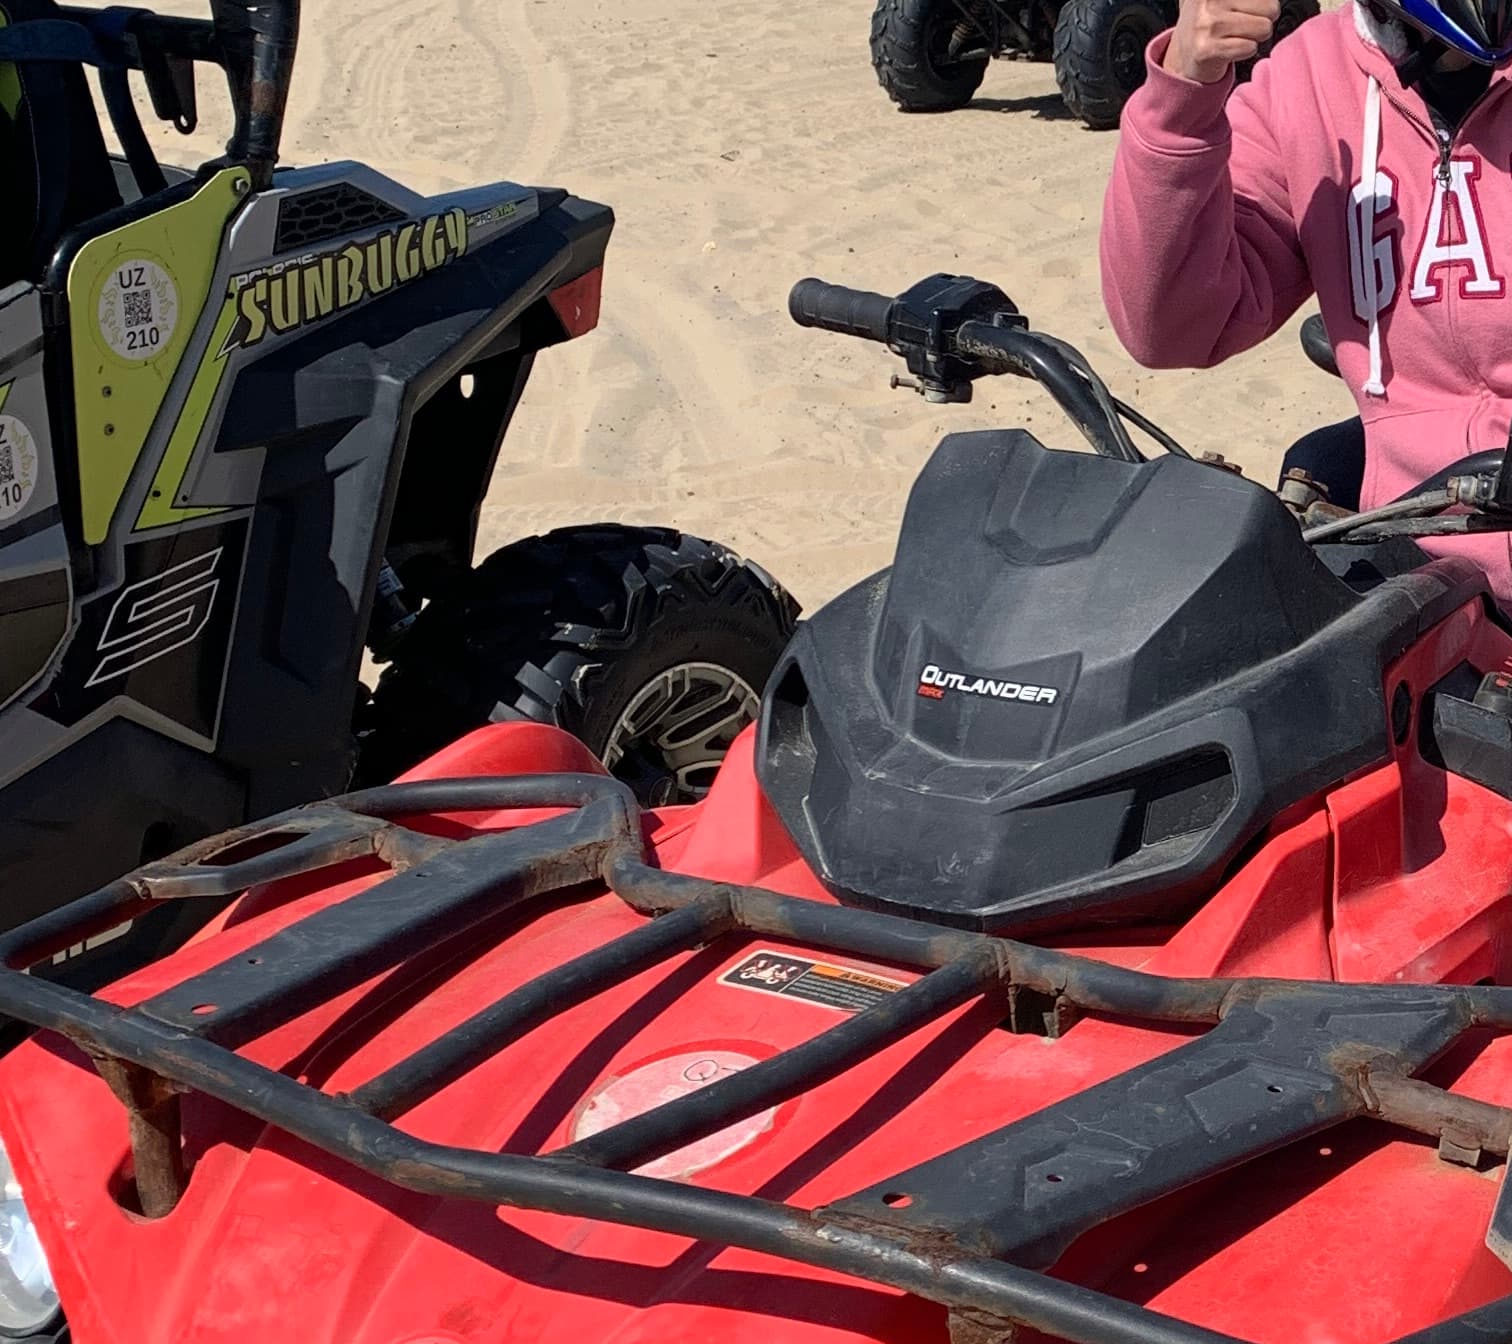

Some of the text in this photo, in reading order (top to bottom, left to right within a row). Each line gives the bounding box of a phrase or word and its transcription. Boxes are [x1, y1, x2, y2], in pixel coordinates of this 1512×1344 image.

[119, 267, 146, 289] UZ
[239, 207, 468, 345] SUNBUGGY
[126, 327, 159, 350] 210
[0, 483, 22, 508] 10
[920, 664, 1058, 704] OUTLANDER
